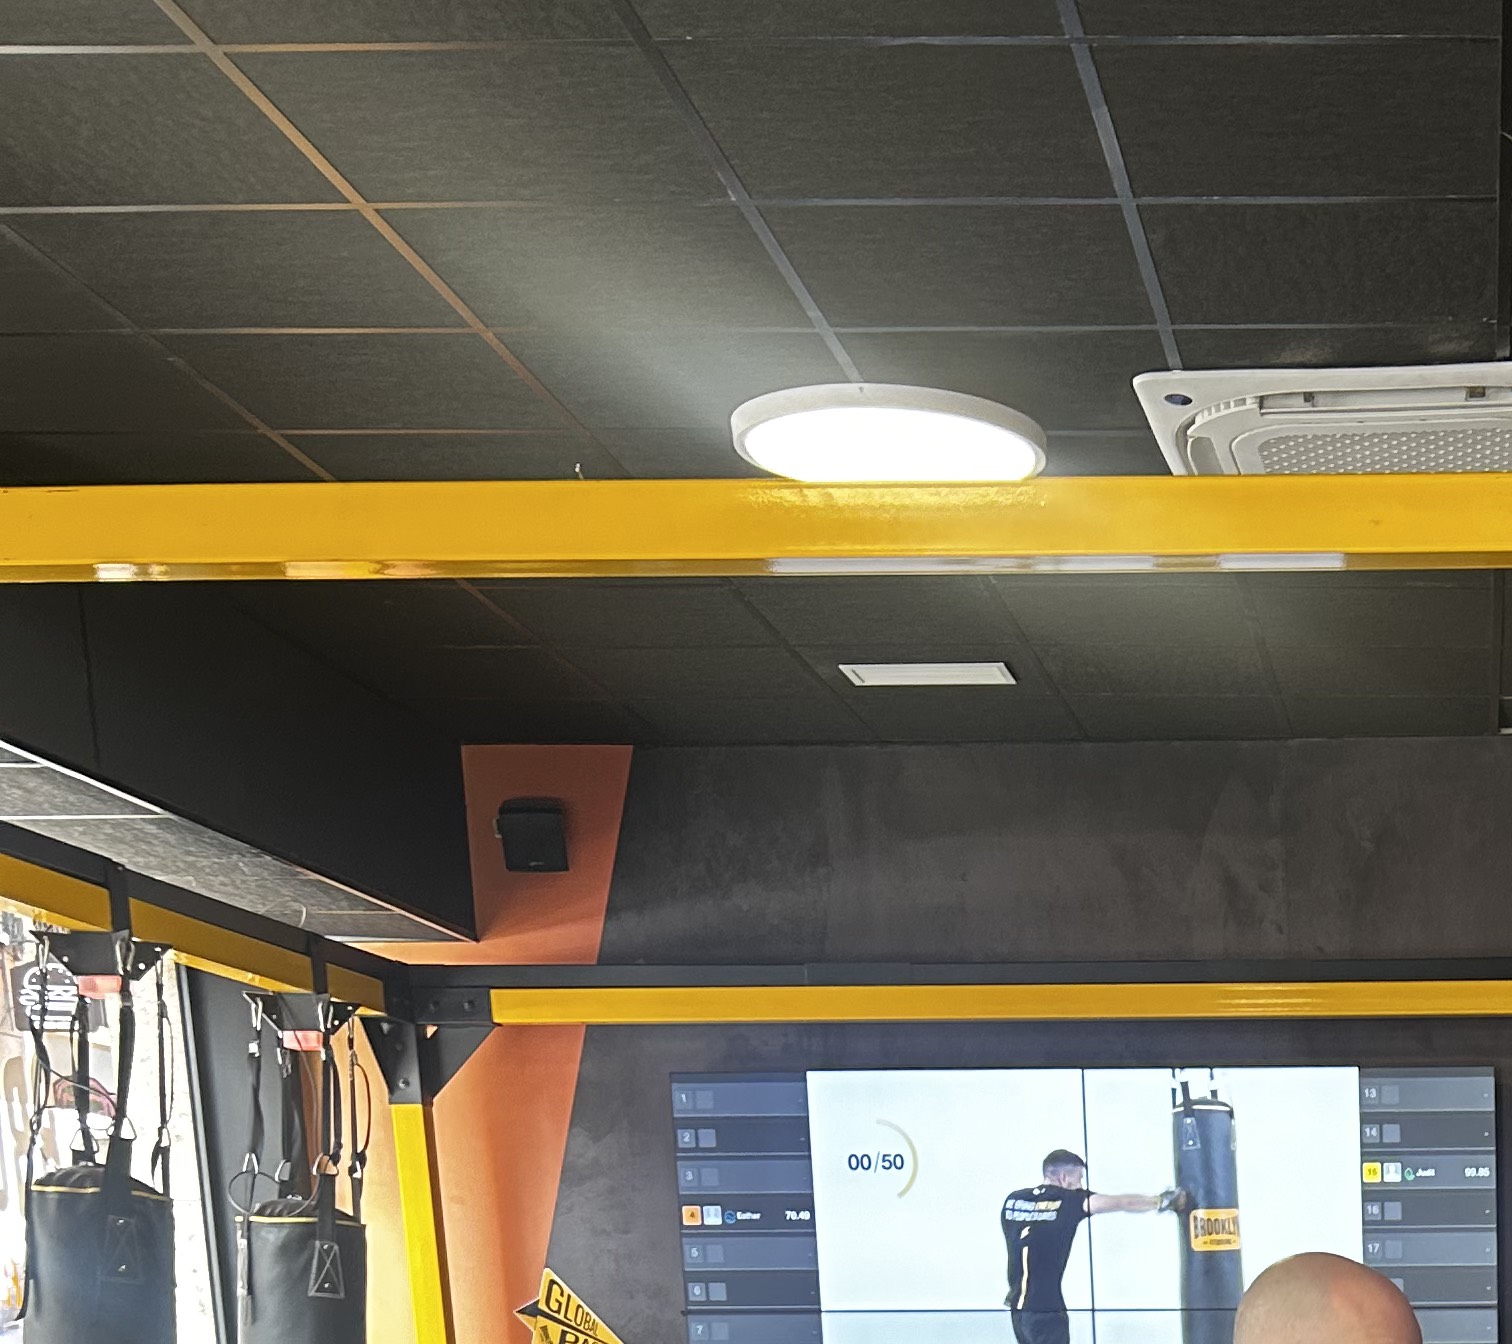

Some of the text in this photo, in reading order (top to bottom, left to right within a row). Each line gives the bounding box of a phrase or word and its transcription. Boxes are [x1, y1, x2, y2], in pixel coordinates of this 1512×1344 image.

[1364, 1088, 1377, 1098] 13
[683, 1132, 690, 1142] 2
[1364, 1127, 1378, 1137] 14
[848, 1151, 904, 1173] 00/50
[685, 1171, 693, 1181] 3
[691, 1248, 699, 1258] 5
[1367, 1244, 1380, 1253] 17
[545, 1279, 599, 1337] GLOBAL
[696, 1325, 703, 1335] 7
